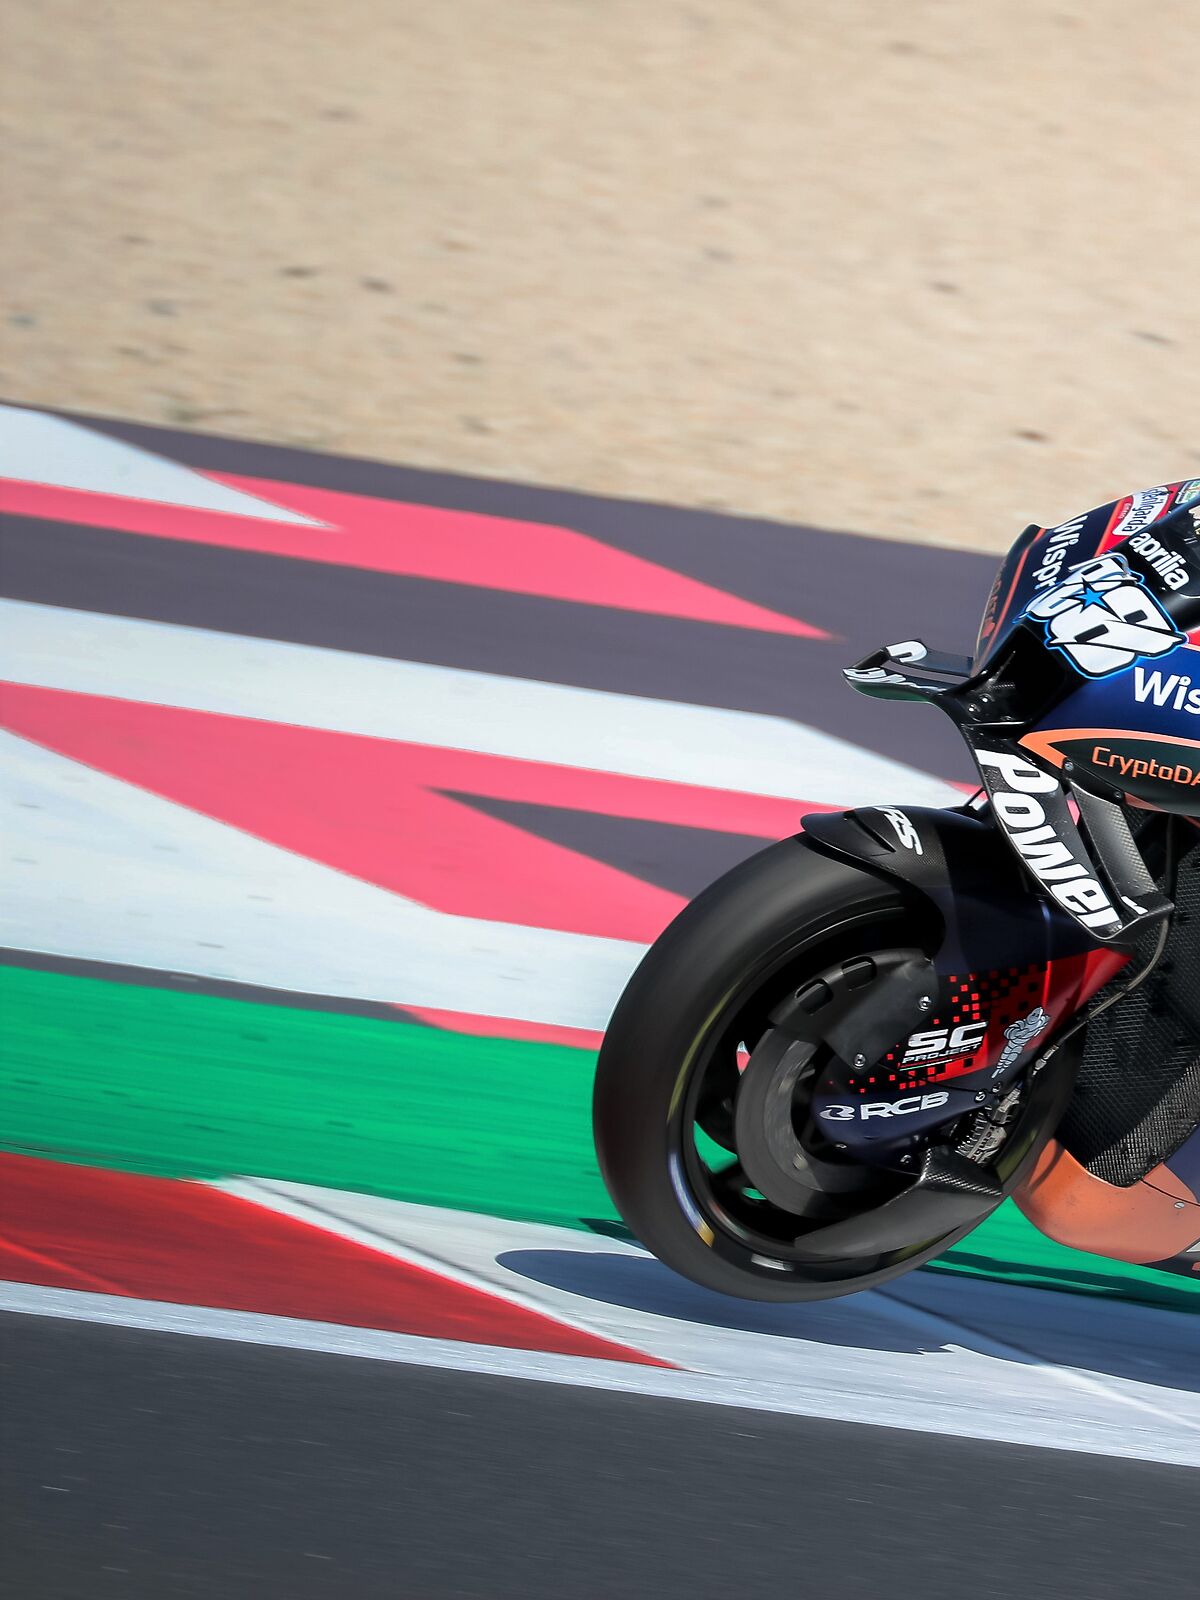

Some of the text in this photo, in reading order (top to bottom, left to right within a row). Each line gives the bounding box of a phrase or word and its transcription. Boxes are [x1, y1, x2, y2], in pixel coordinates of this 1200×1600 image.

[1031, 515, 1089, 591] Wispr
[1128, 532, 1190, 591] aprilia
[901, 1042, 983, 1064] PROJECT
[904, 1021, 989, 1057] SC
[860, 1090, 950, 1121] RCB
